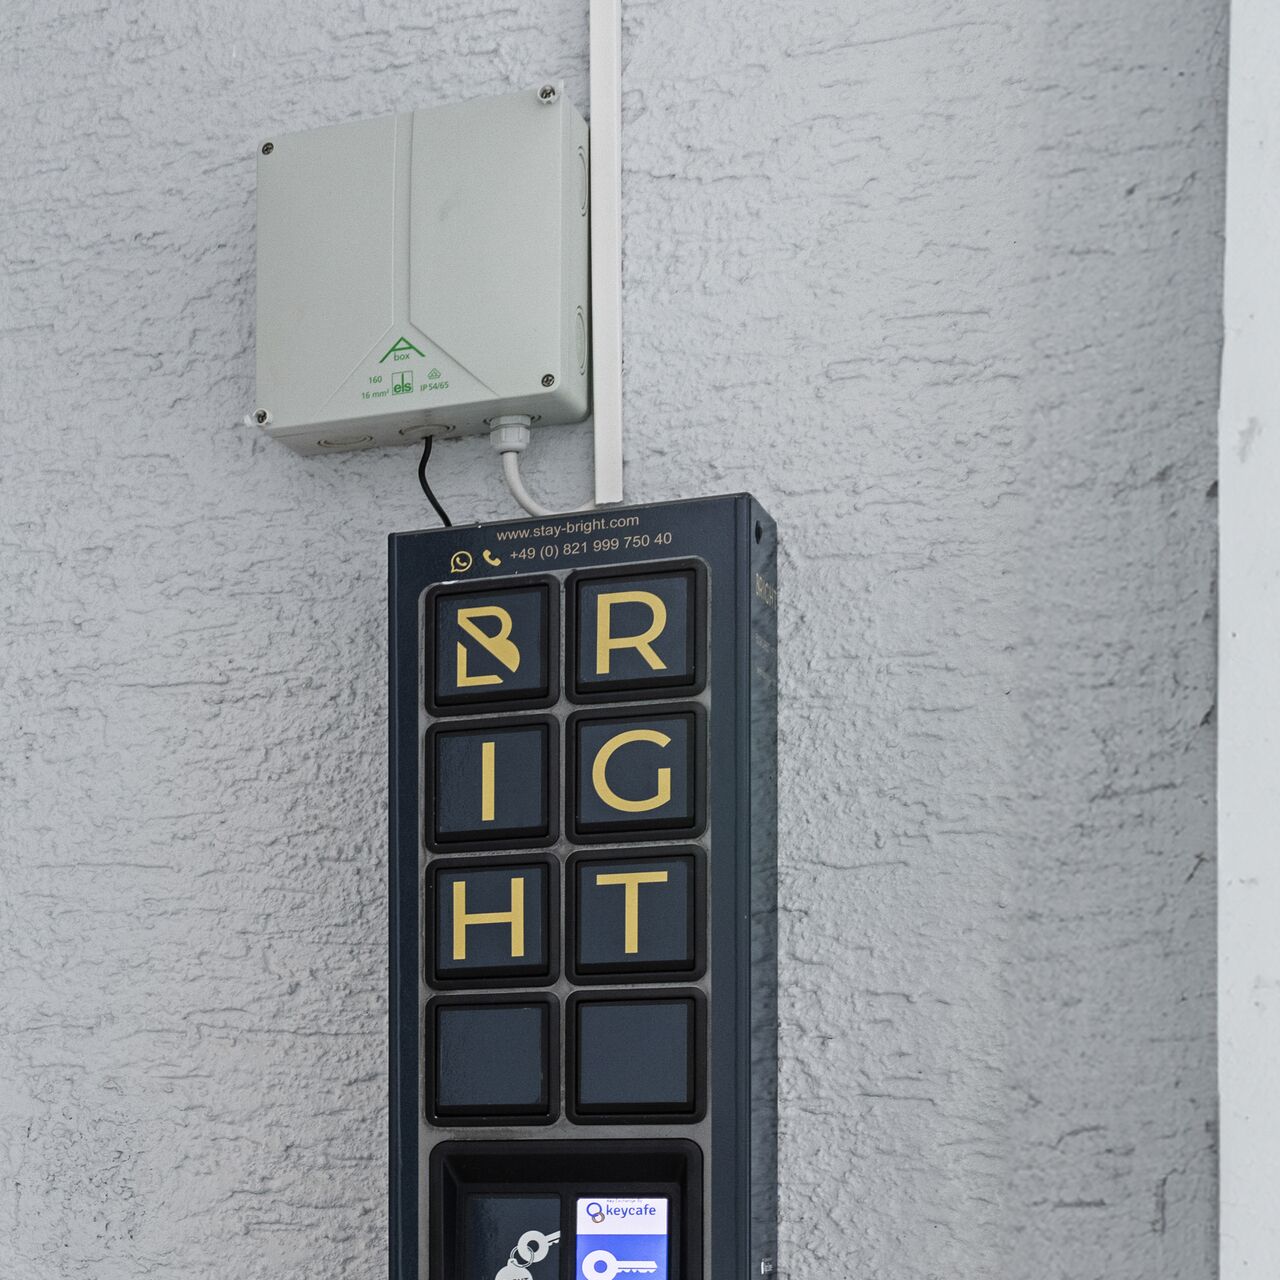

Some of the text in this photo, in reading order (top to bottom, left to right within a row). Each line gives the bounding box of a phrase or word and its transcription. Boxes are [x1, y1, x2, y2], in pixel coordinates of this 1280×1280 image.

[393, 352, 410, 361] box
[368, 376, 383, 384] 160
[428, 381, 449, 390] 54/65
[361, 391, 370, 399] 16
[496, 516, 640, 541] www.stay-bright.com
[510, 532, 672, 561] +49 (0) 821 999 750 40
[457, 590, 667, 687] B R
[482, 729, 672, 822] I G
[453, 871, 668, 960] H T
[606, 1203, 656, 1218] keycafe
